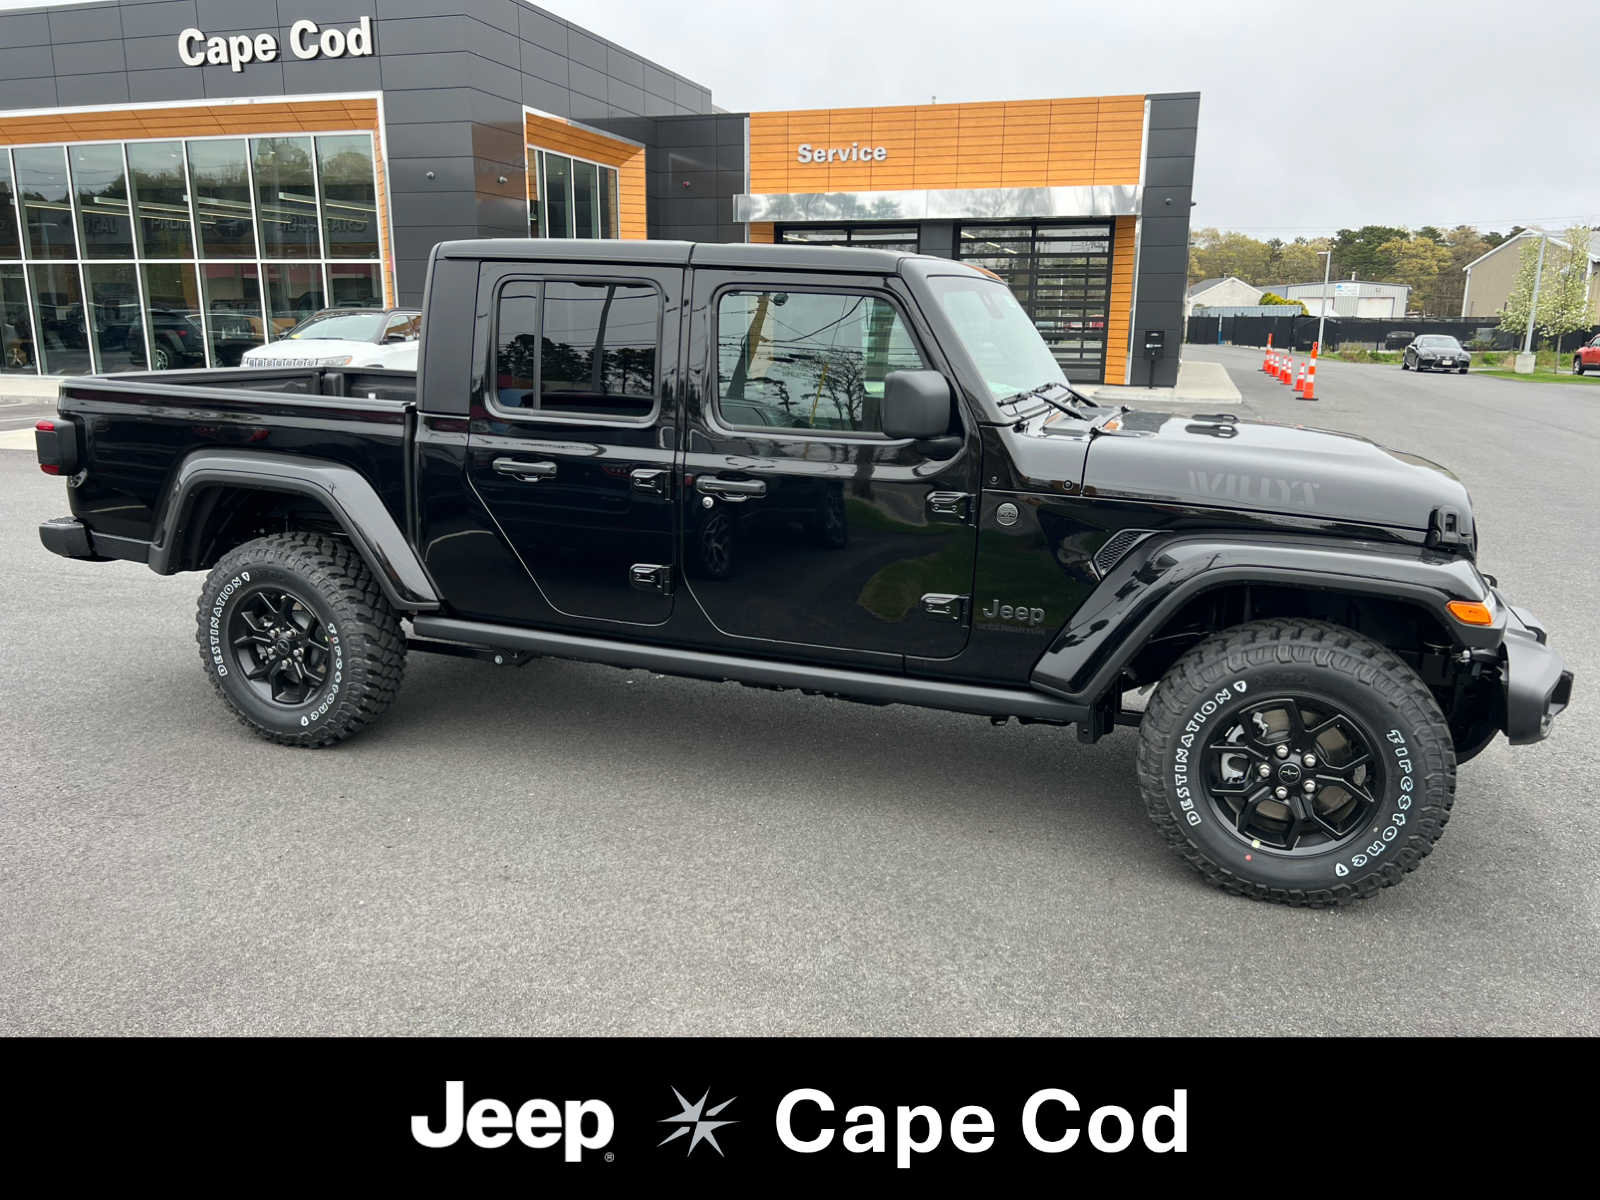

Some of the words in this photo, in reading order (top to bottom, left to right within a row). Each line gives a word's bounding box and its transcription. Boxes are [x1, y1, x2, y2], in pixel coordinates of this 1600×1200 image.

[178, 27, 277, 73] Cape
[289, 15, 374, 60] Cod
[797, 142, 888, 163] Service
[209, 576, 242, 677] DESTINATION
[981, 598, 1046, 626] Jeep
[1174, 688, 1231, 826] DESTINATION
